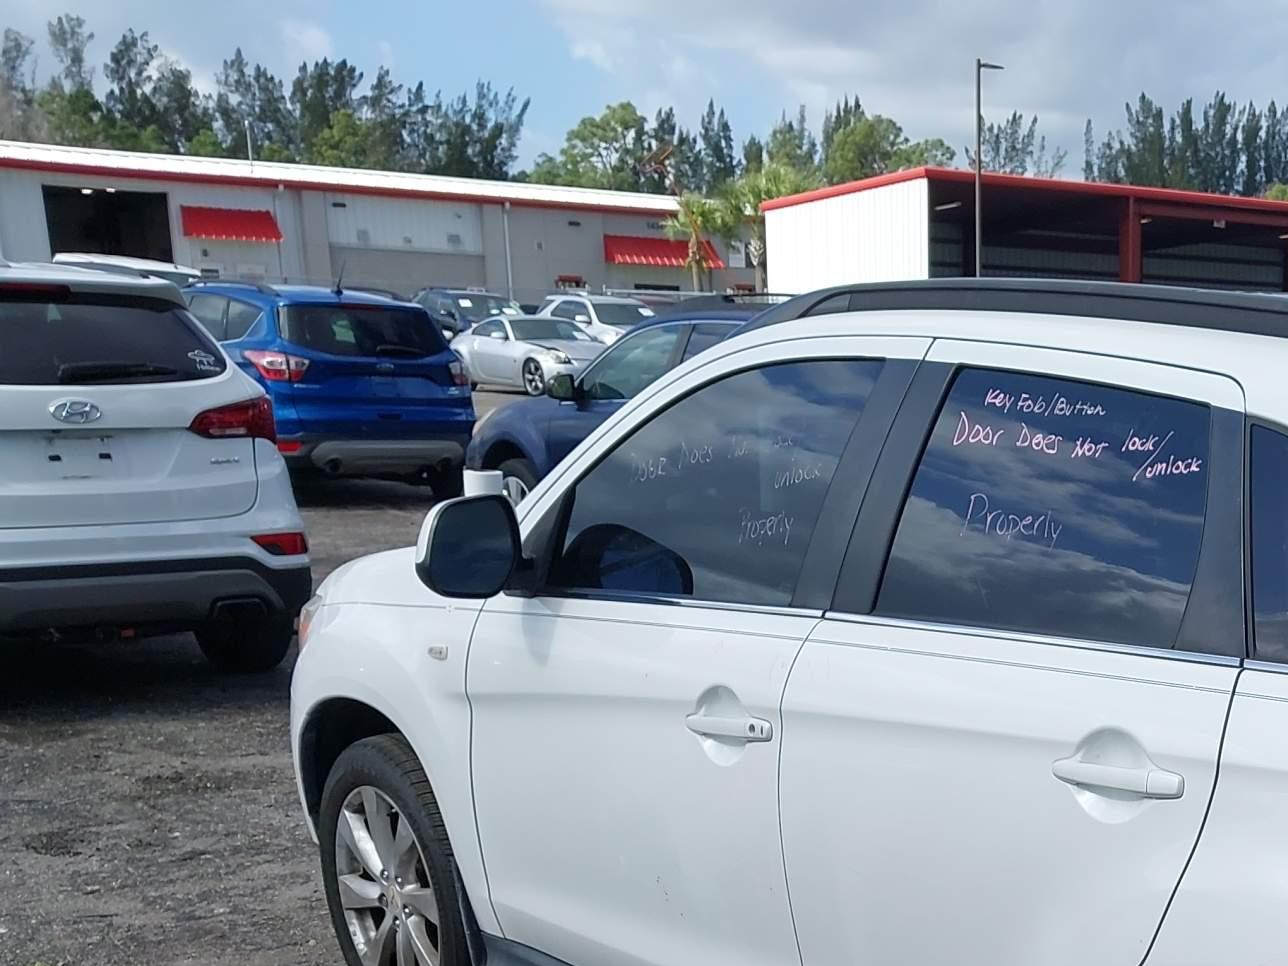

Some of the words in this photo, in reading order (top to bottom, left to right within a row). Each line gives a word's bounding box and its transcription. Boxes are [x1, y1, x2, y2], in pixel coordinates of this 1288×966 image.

[984, 388, 1015, 414] Key
[952, 410, 1004, 447] Door
[1016, 422, 1063, 455] Does
[959, 493, 1062, 552] Properly
